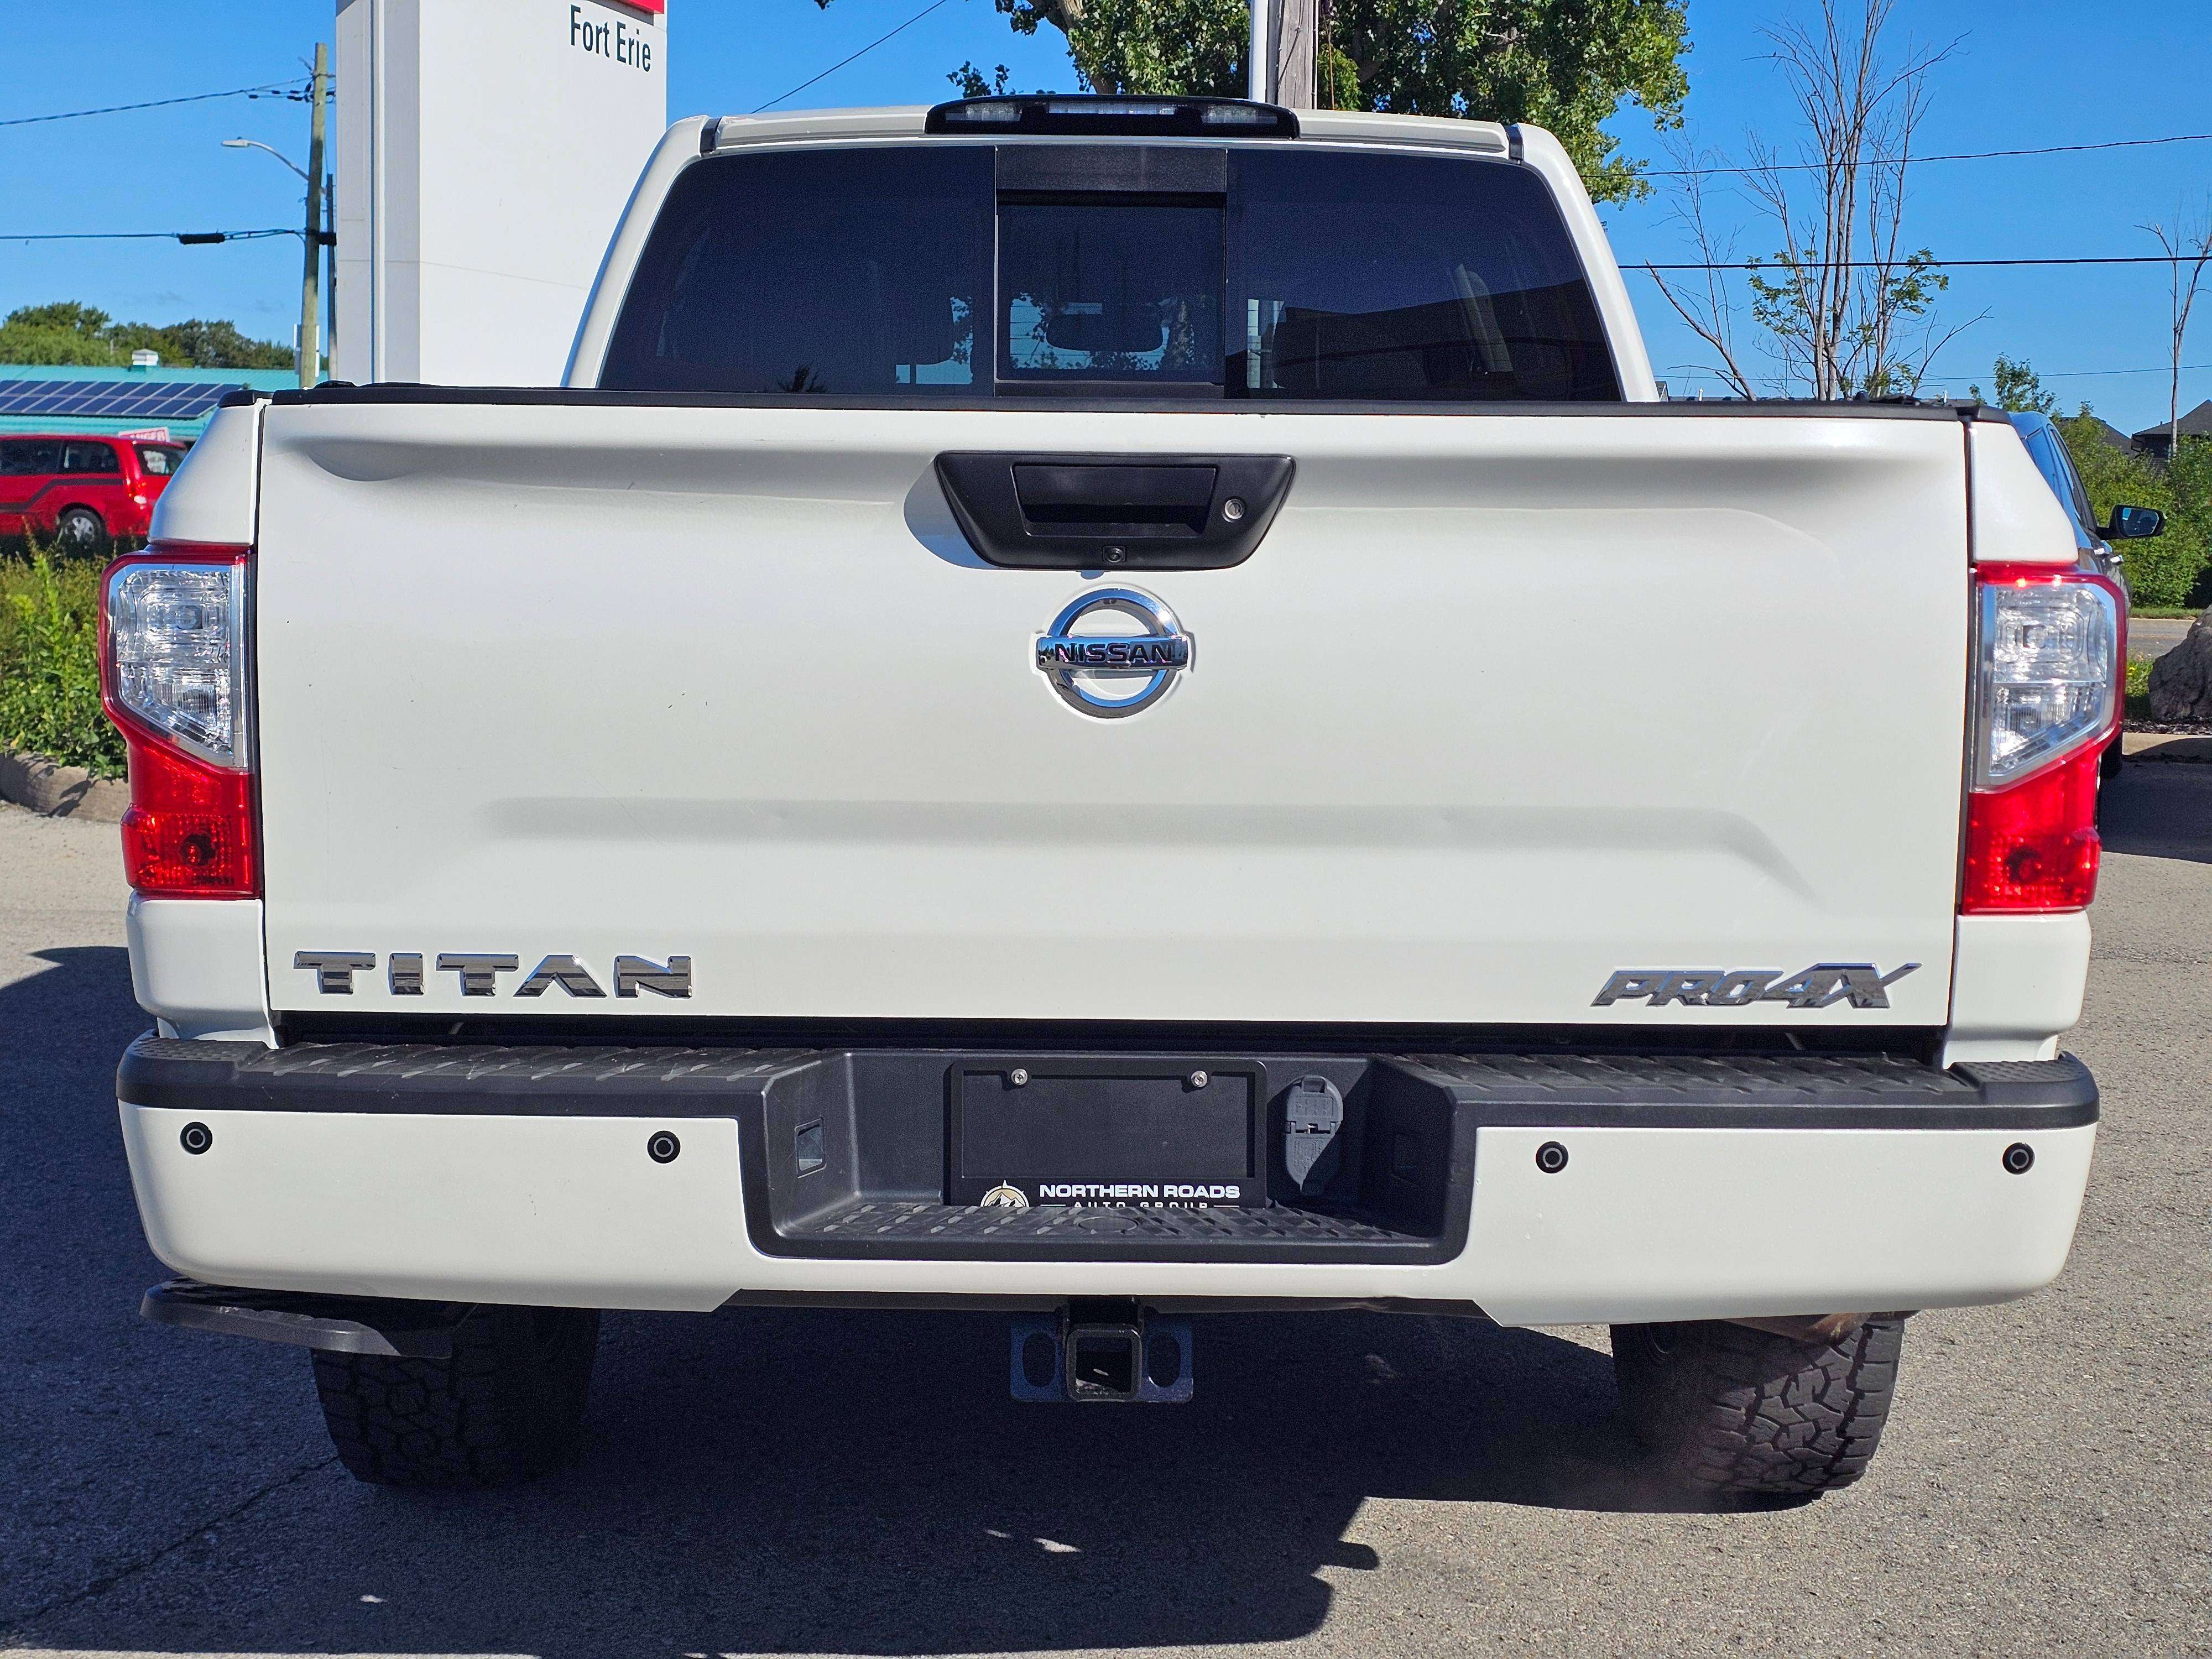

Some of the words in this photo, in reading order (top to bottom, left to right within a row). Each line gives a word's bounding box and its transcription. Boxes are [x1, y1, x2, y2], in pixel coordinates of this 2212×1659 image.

[571, 4, 610, 58] Fort
[617, 20, 651, 72] Erie
[1054, 641, 1173, 663] NISSAN
[293, 951, 692, 998] TITAN
[1040, 1185, 1159, 1198] NORTHERN
[1164, 1185, 1240, 1198] ROADS
